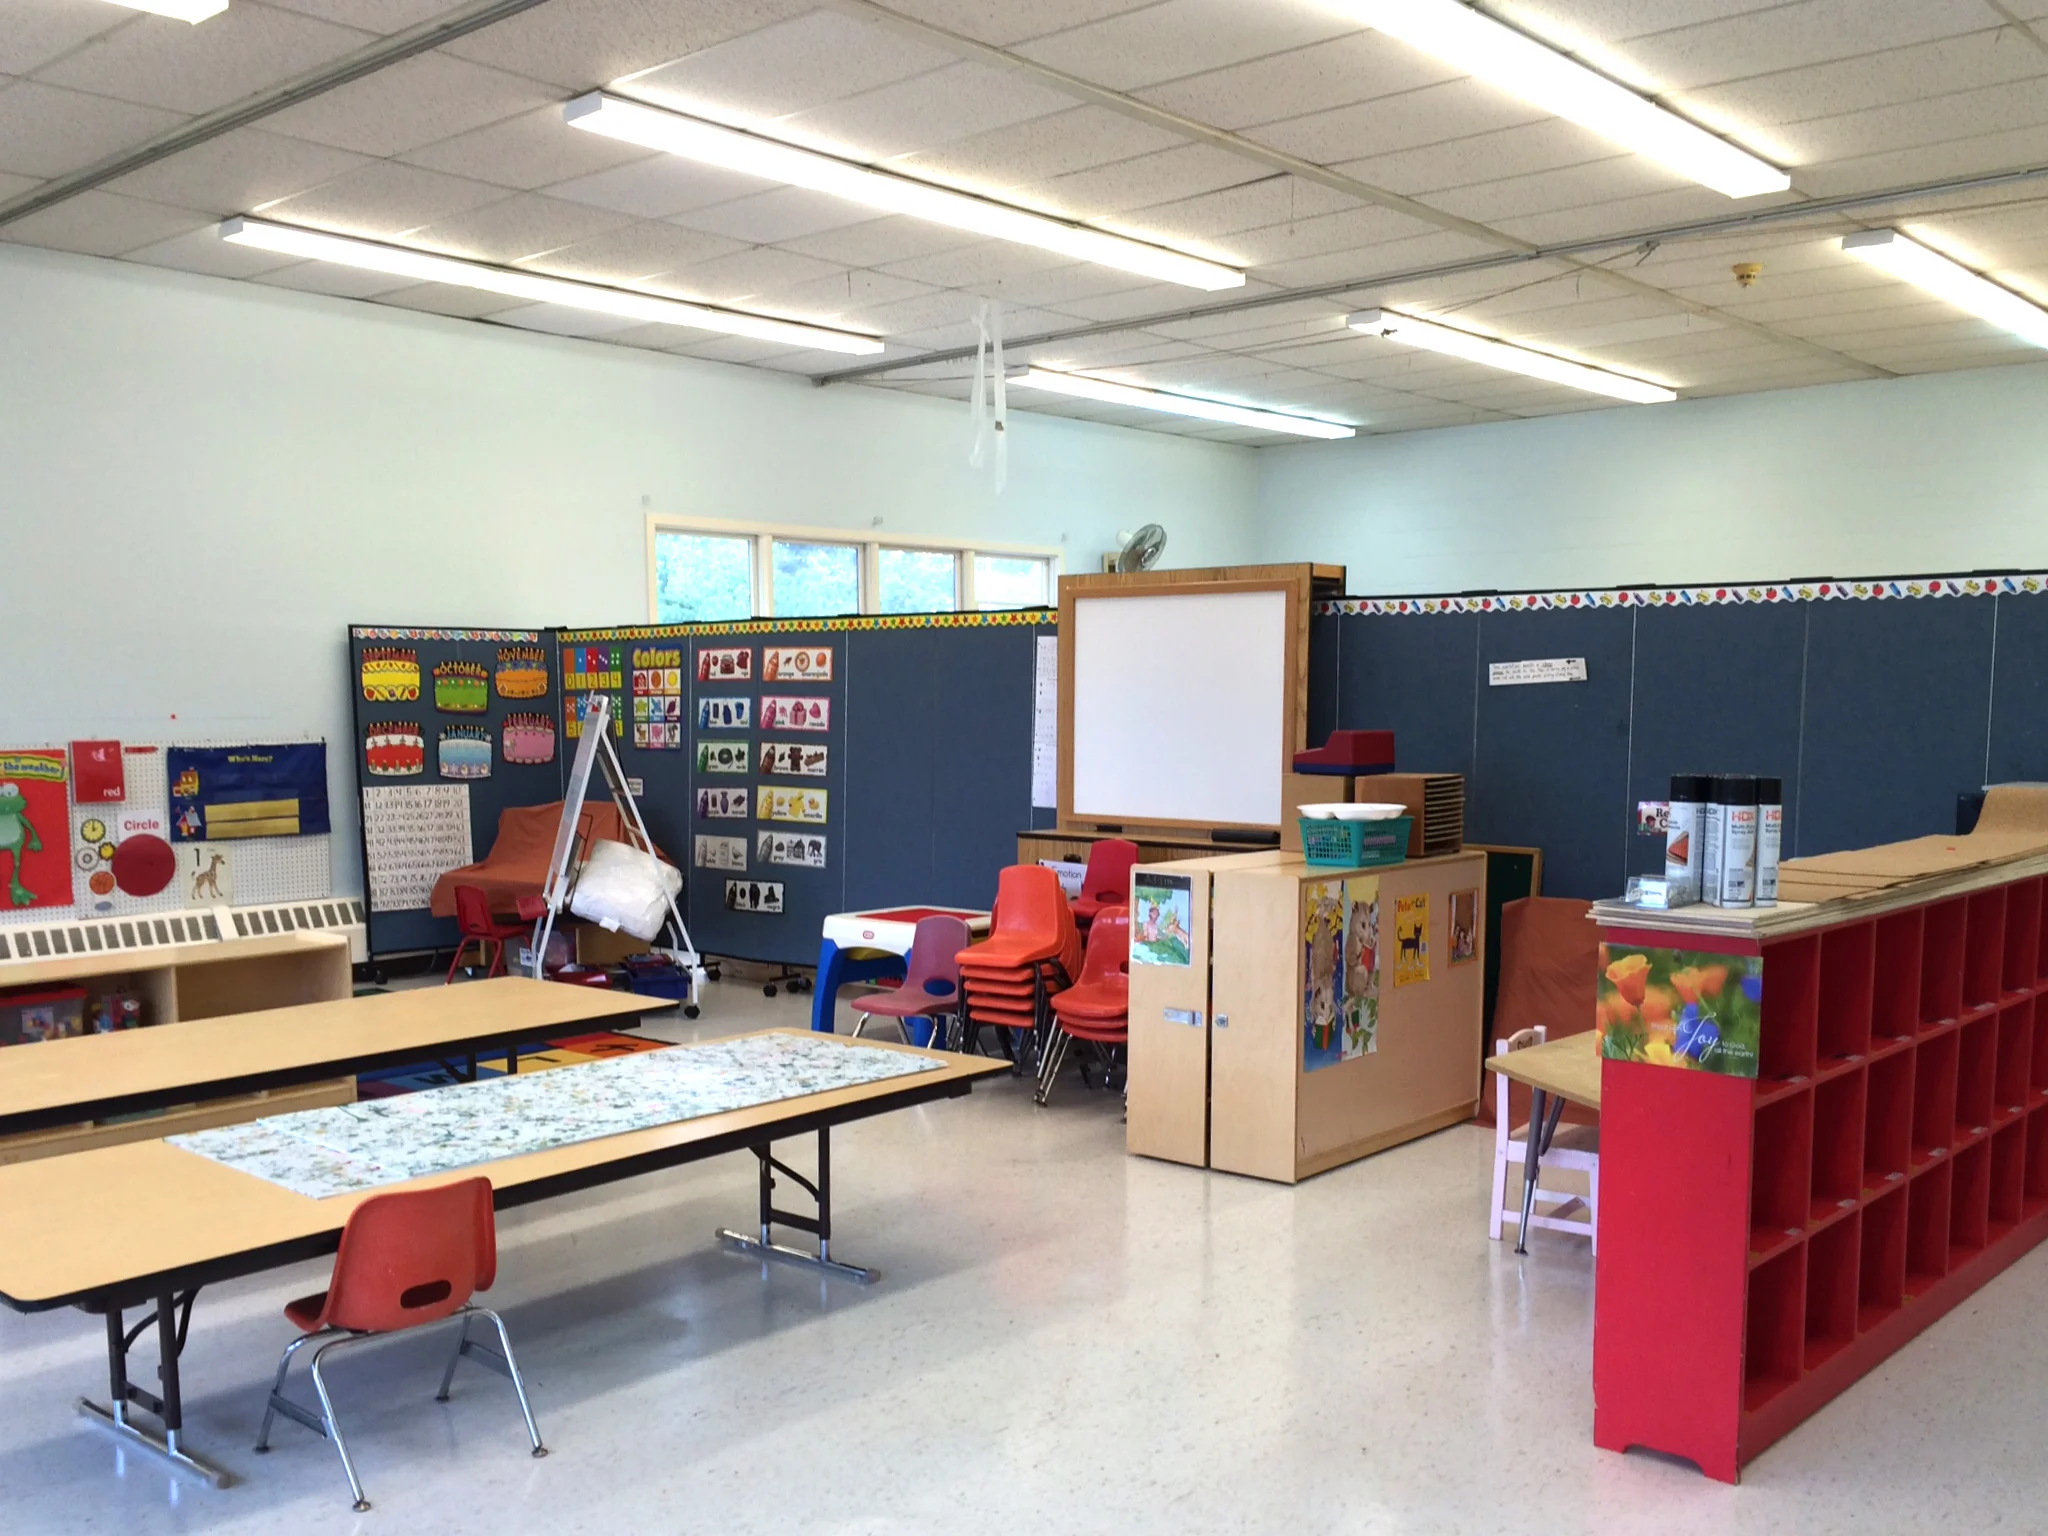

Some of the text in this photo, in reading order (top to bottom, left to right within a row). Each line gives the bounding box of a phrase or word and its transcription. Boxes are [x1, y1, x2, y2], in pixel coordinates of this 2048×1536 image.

[497, 650, 545, 662] NOVEMBER
[633, 648, 681, 668] Colors
[440, 663, 481, 675] OCTOBER
[566, 673, 619, 687] 0 1 2 3 4
[447, 728, 484, 740] JANUARY
[568, 723, 574, 735] 5
[104, 786, 120, 797] red
[365, 789, 369, 798] 1
[376, 788, 381, 797] 2
[389, 788, 392, 796] 3
[406, 787, 412, 796] 5
[415, 788, 421, 796] 6
[427, 787, 431, 795] 7
[453, 786, 461, 794] 10
[1766, 810, 1781, 820] HD
[124, 820, 160, 830] Circle
[194, 848, 200, 866] 1
[1416, 897, 1426, 908] Cat
[1674, 1012, 1718, 1063] Joy
